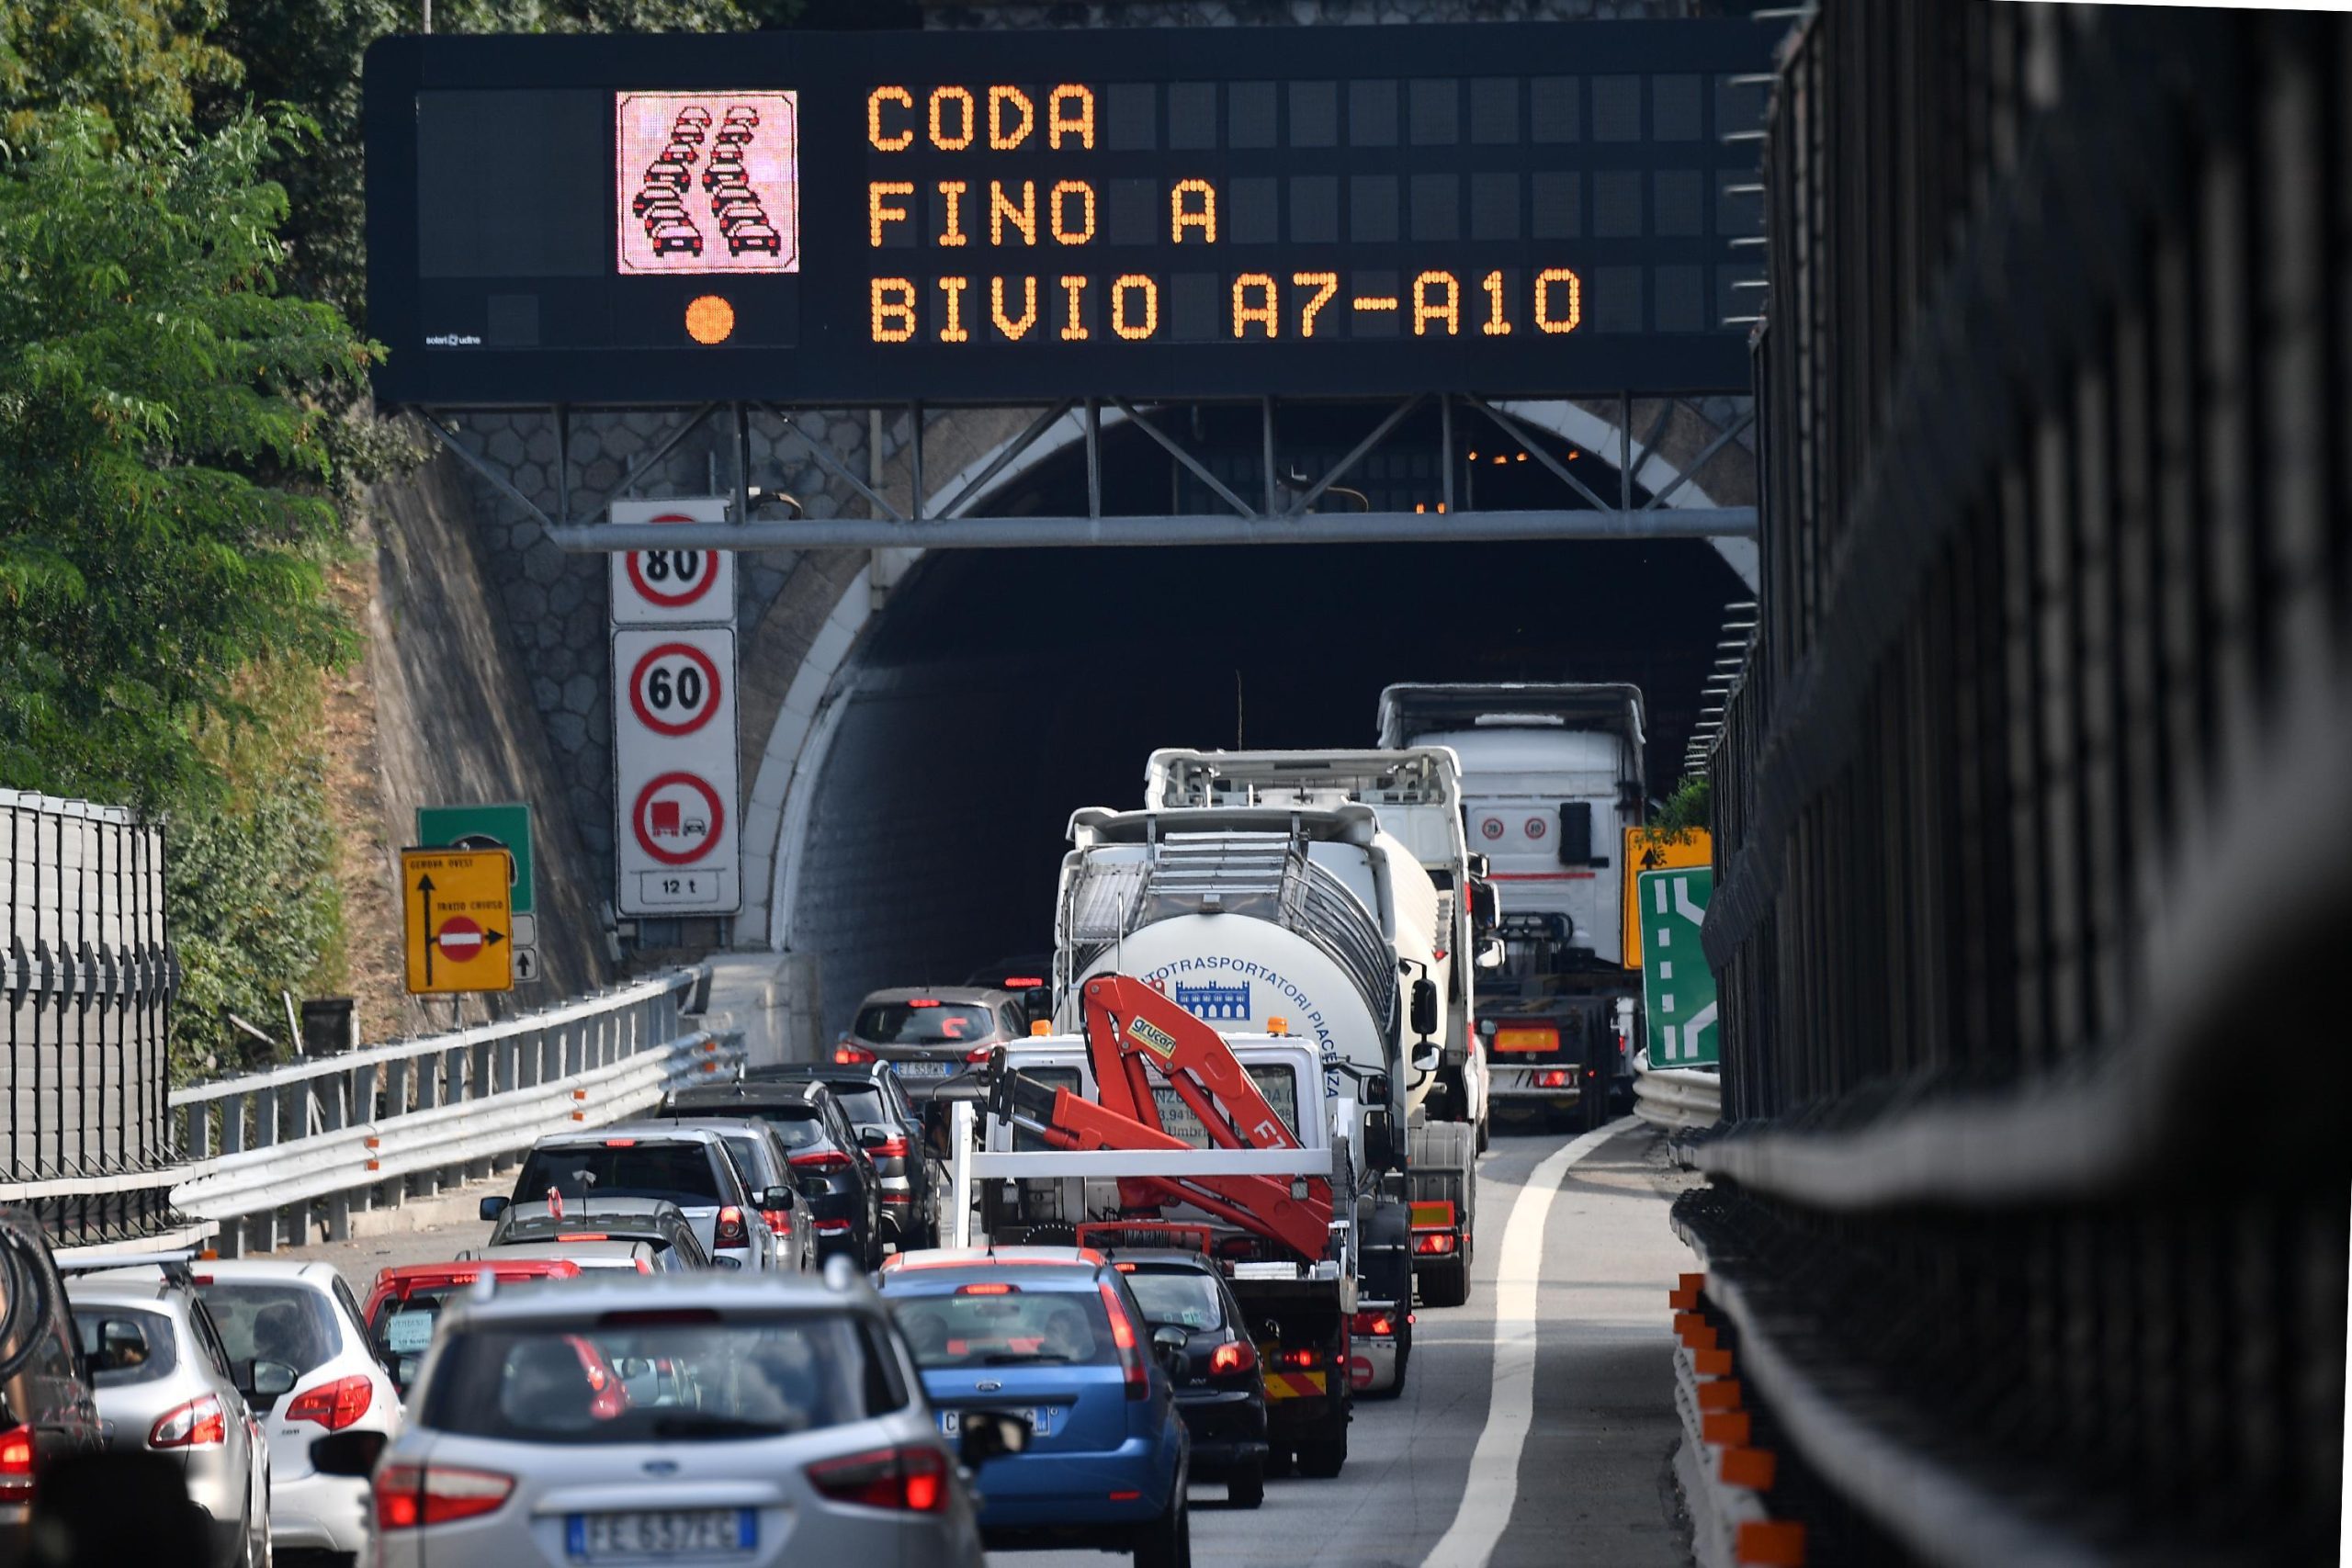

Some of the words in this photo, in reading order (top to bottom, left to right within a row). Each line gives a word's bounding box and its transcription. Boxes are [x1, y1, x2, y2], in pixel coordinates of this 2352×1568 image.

[867, 84, 1093, 151] CODA
[869, 179, 1094, 246] FINO
[1171, 179, 1216, 243] A
[871, 274, 1157, 342] BIVIO
[1232, 268, 1580, 338] A7-A10
[647, 549, 698, 581] 80
[649, 667, 701, 710] 60
[662, 879, 680, 894] 12
[688, 879, 696, 894] t
[1141, 956, 1312, 1011] TOTRASPORTATORI
